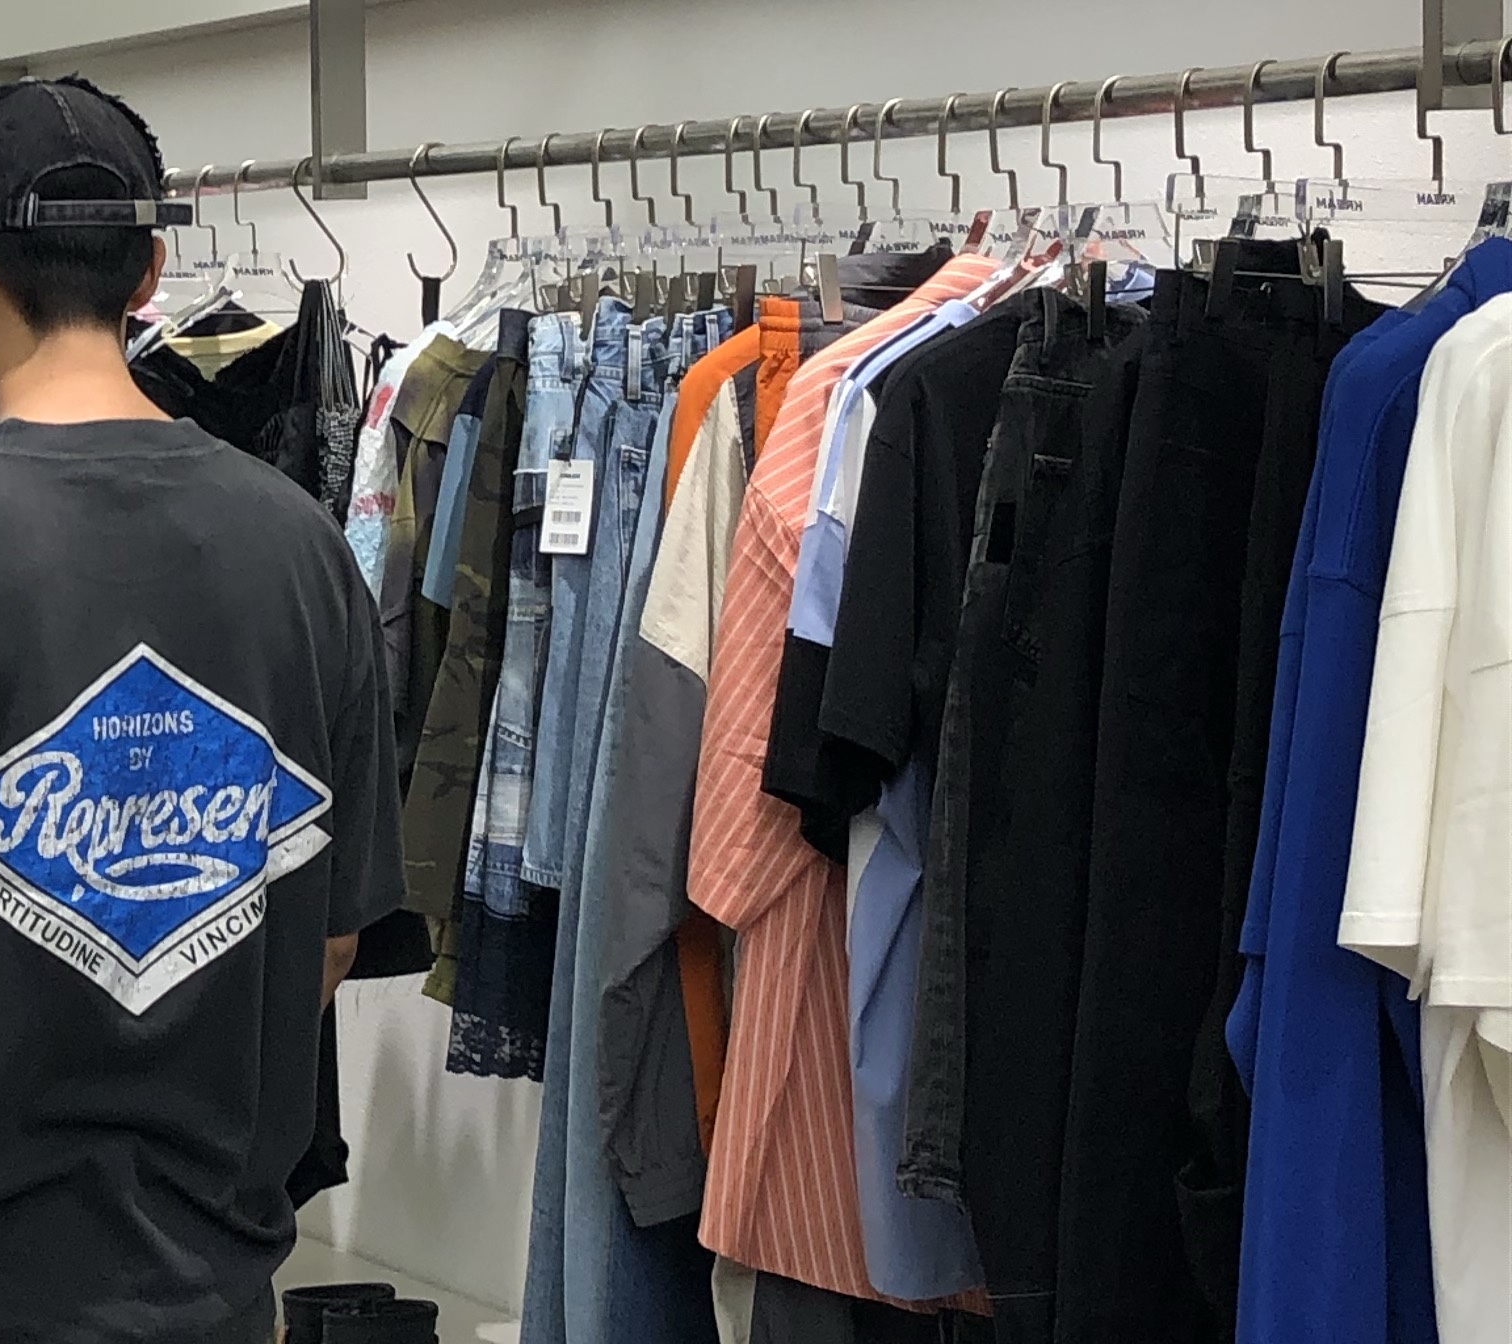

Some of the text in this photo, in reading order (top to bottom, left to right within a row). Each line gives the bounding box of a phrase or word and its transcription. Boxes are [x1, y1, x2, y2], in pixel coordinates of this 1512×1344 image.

[92, 709, 194, 741] HORIZONS
[129, 745, 154, 772] BY
[180, 894, 266, 967] VINCIM
